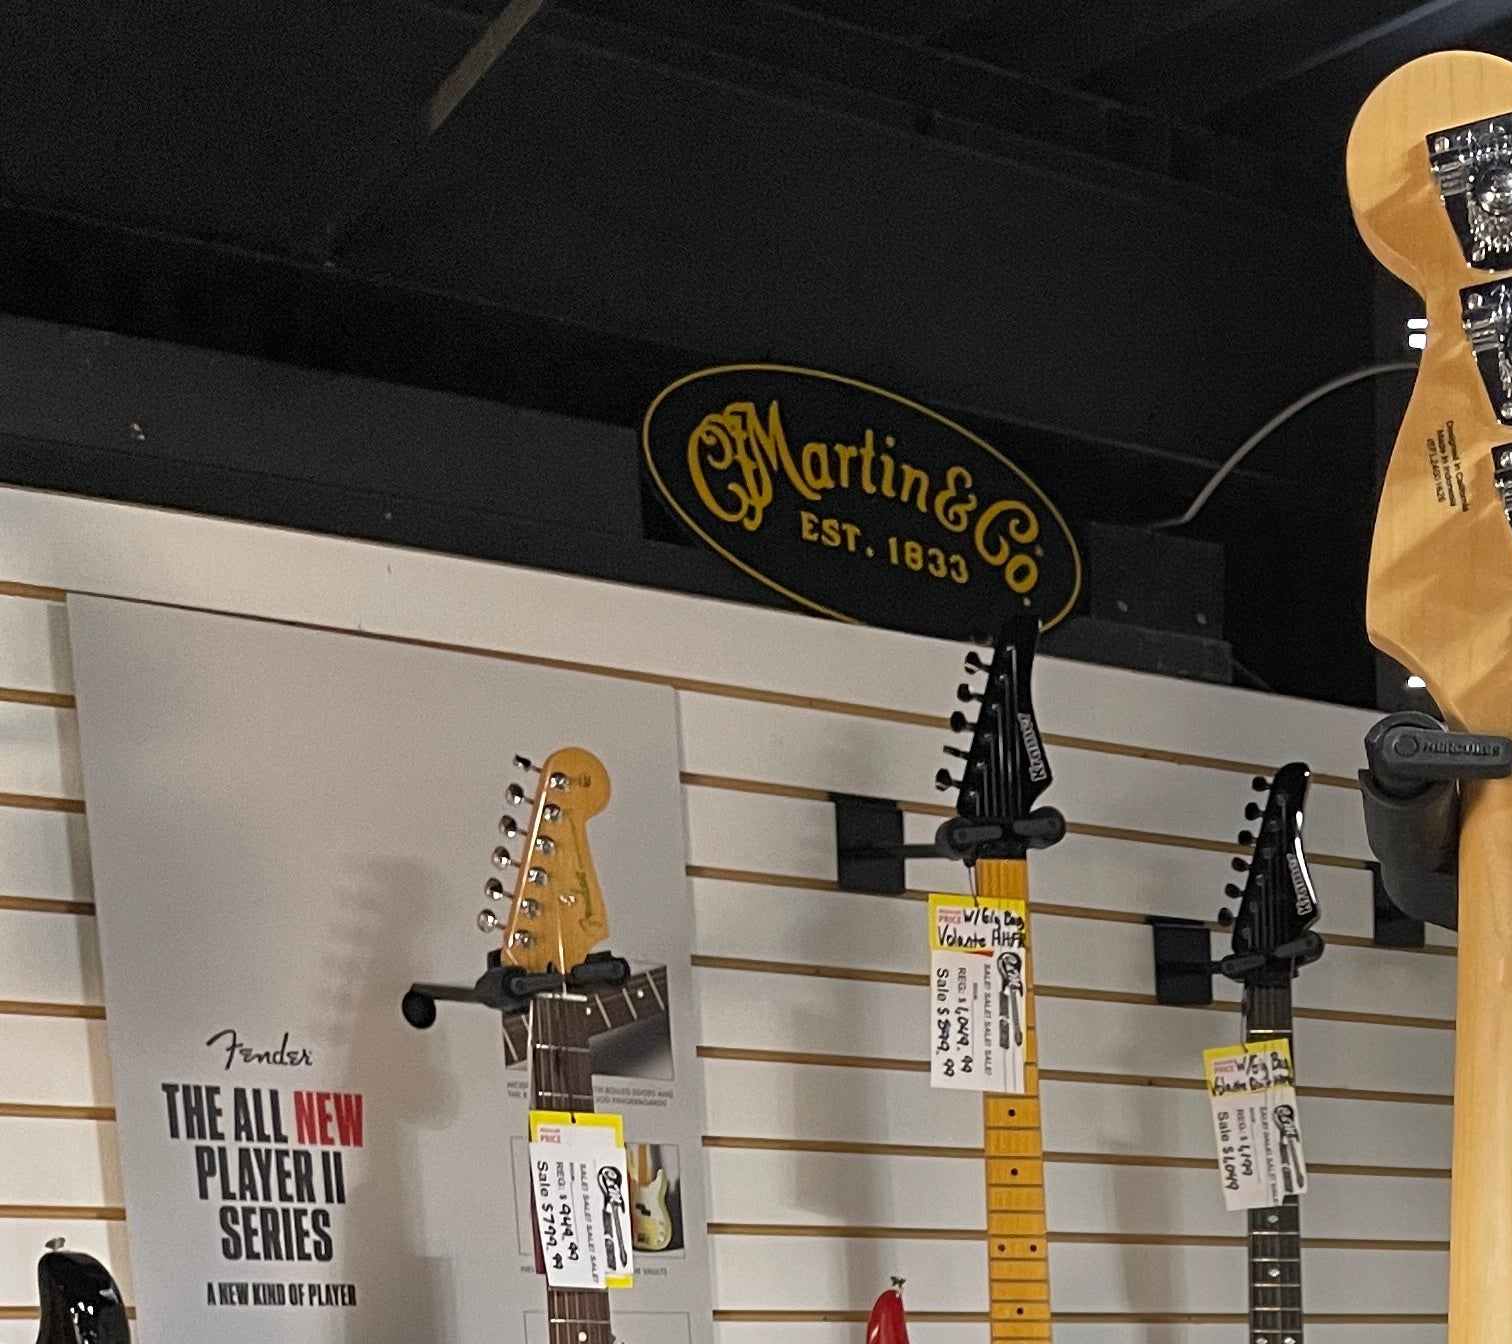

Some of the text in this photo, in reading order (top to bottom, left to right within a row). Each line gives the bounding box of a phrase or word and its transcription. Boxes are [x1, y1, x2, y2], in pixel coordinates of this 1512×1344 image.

[800, 510, 970, 584] EST. 1833
[206, 1029, 313, 1069] Fender
[162, 1083, 364, 1148] THE ALL NEW
[196, 1147, 346, 1204] PLAYER II
[537, 1160, 549, 1197] Sale
[220, 1205, 333, 1262] SERIES
[207, 1282, 357, 1306] A NEW KIND OF PLAYER
